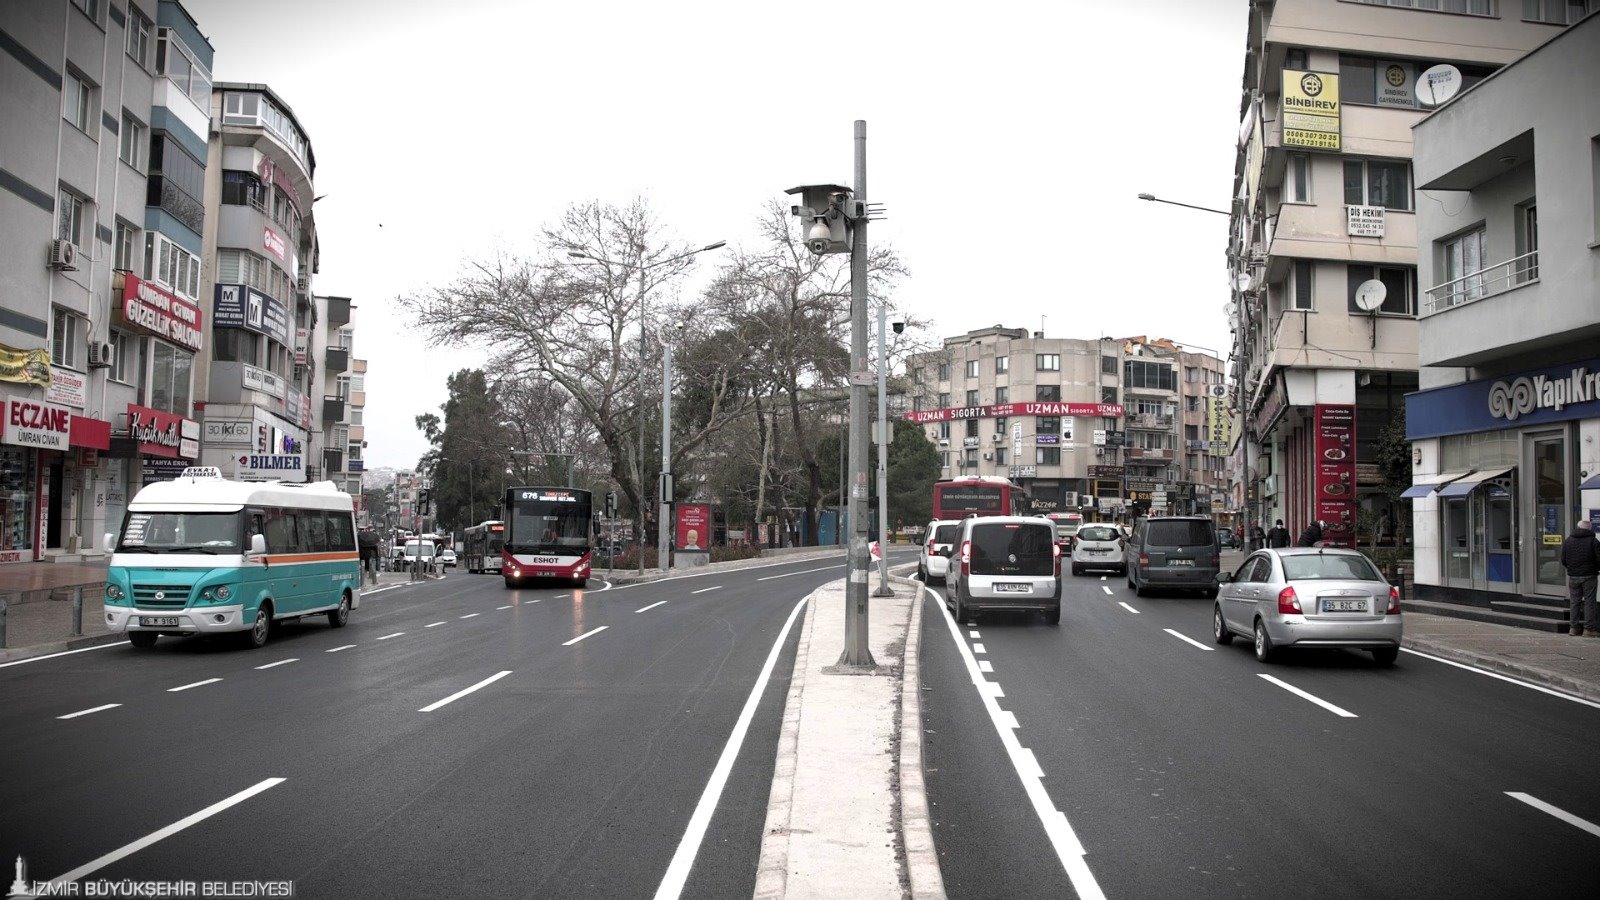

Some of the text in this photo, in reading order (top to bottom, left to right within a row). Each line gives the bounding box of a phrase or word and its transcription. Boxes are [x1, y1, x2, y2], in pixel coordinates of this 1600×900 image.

[1285, 96, 1337, 110] BİNBİREV
[1362, 208, 1384, 218] HEKİMİ
[137, 280, 196, 324] ÜMRAN CİVAN
[126, 298, 203, 350] GÜZELLİK SALONU
[917, 410, 944, 421] UZMAN
[950, 407, 986, 419] SİGORTA
[1026, 403, 1069, 414] UZMAN
[1097, 404, 1122, 413] UZMAN
[10, 400, 69, 433] ECZANE
[208, 425, 220, 435] 30
[236, 425, 249, 435] 60
[18, 428, 60, 447] ÜMRAN CİVAN
[1327, 601, 1336, 610] 35
